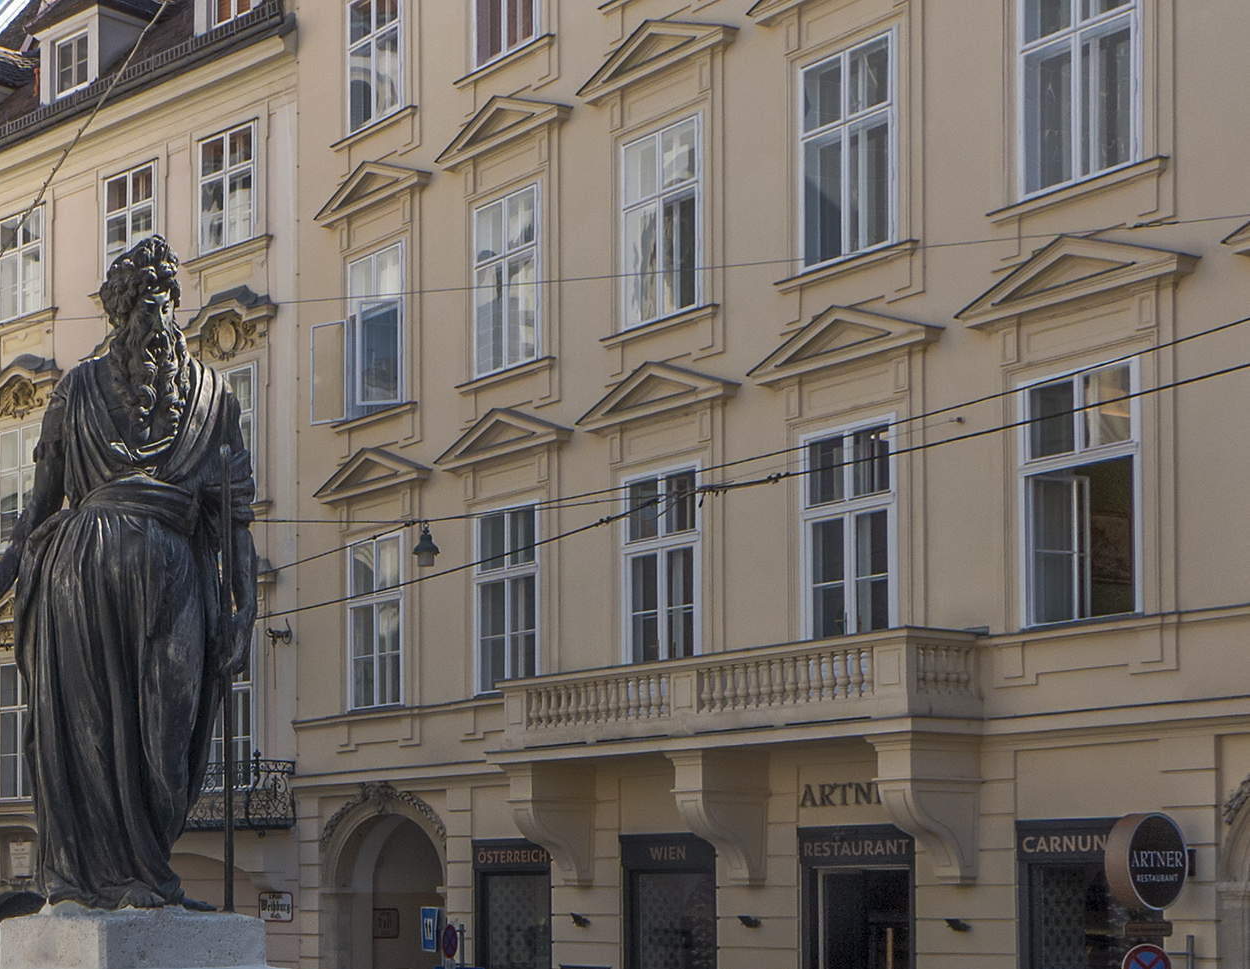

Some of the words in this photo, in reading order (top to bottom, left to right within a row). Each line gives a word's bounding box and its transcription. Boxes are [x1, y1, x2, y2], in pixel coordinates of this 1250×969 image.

[477, 847, 547, 864] ÖSTERREICH
[649, 846, 686, 860] WIEN
[803, 839, 909, 857] RESTAURANT
[1130, 850, 1183, 867] ARTNER
[1136, 873, 1178, 883] RESTAURANT
[260, 899, 291, 914] Weihburg
